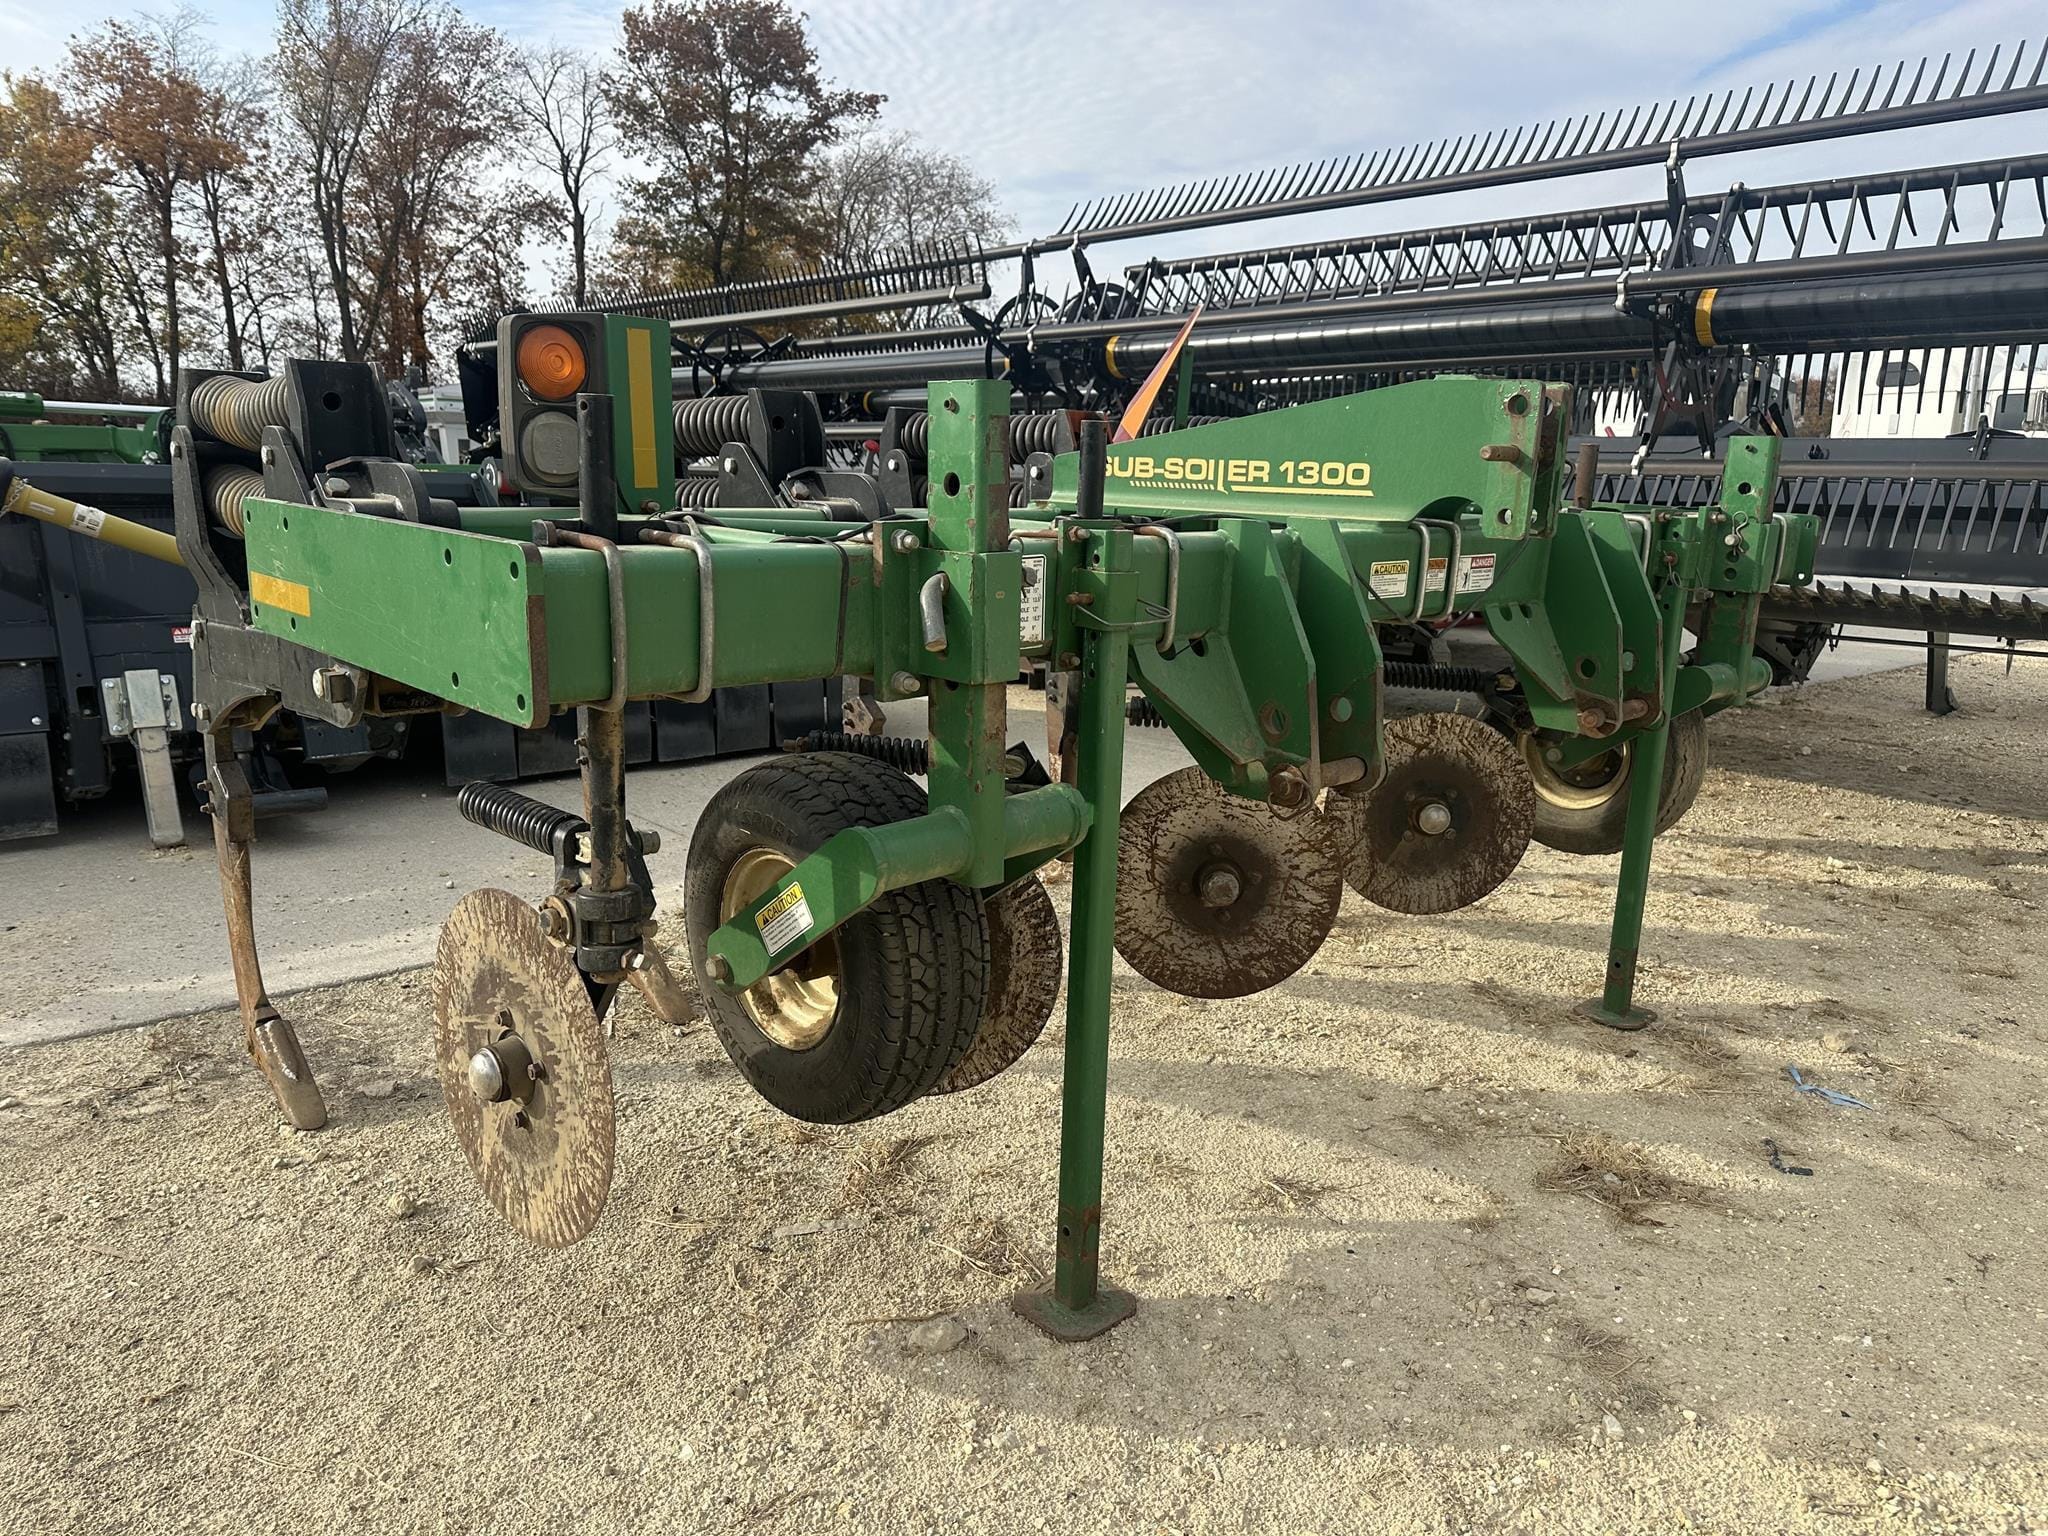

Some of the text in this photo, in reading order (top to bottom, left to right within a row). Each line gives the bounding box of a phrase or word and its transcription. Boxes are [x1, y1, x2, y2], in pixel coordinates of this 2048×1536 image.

[1279, 460, 1371, 487] 1300
[1379, 564, 1406, 574] CAUTION
[767, 889, 798, 920] CAUTION
